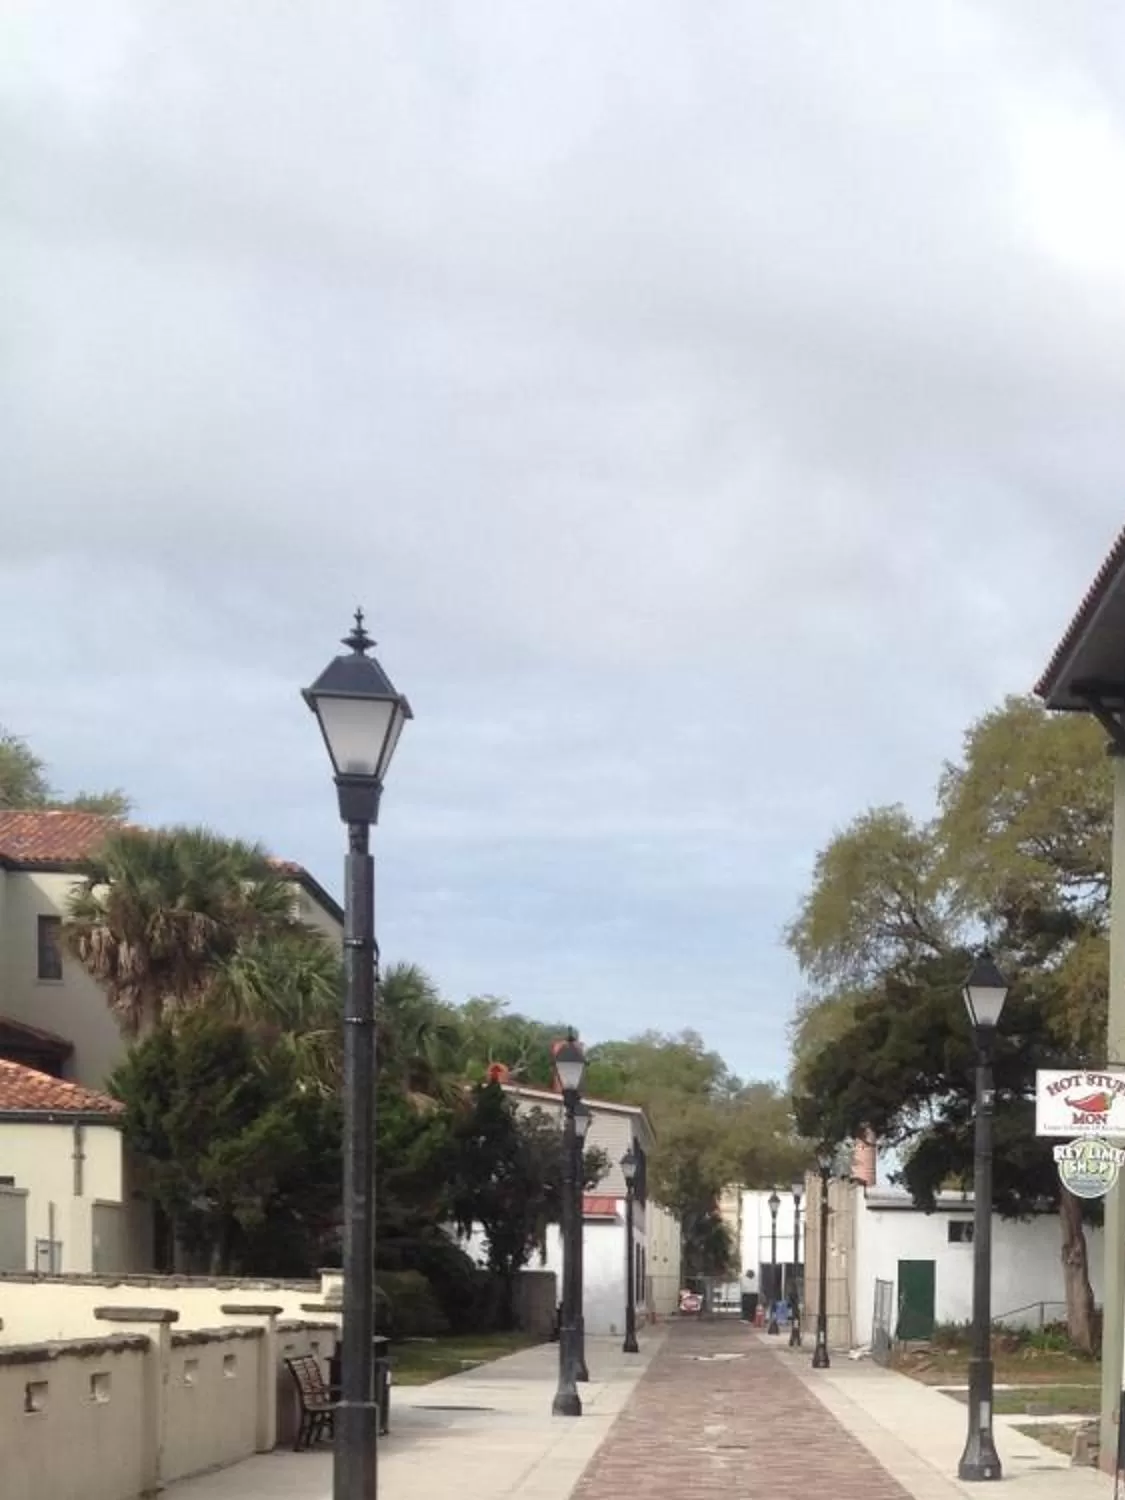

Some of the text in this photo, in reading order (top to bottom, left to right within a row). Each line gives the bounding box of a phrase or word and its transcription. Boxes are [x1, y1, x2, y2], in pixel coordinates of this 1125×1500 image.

[1045, 1075, 1082, 1097] HOT
[1072, 1111, 1108, 1125] MON
[1053, 1145, 1087, 1162] KEY
[1069, 1159, 1110, 1174] SHOP
